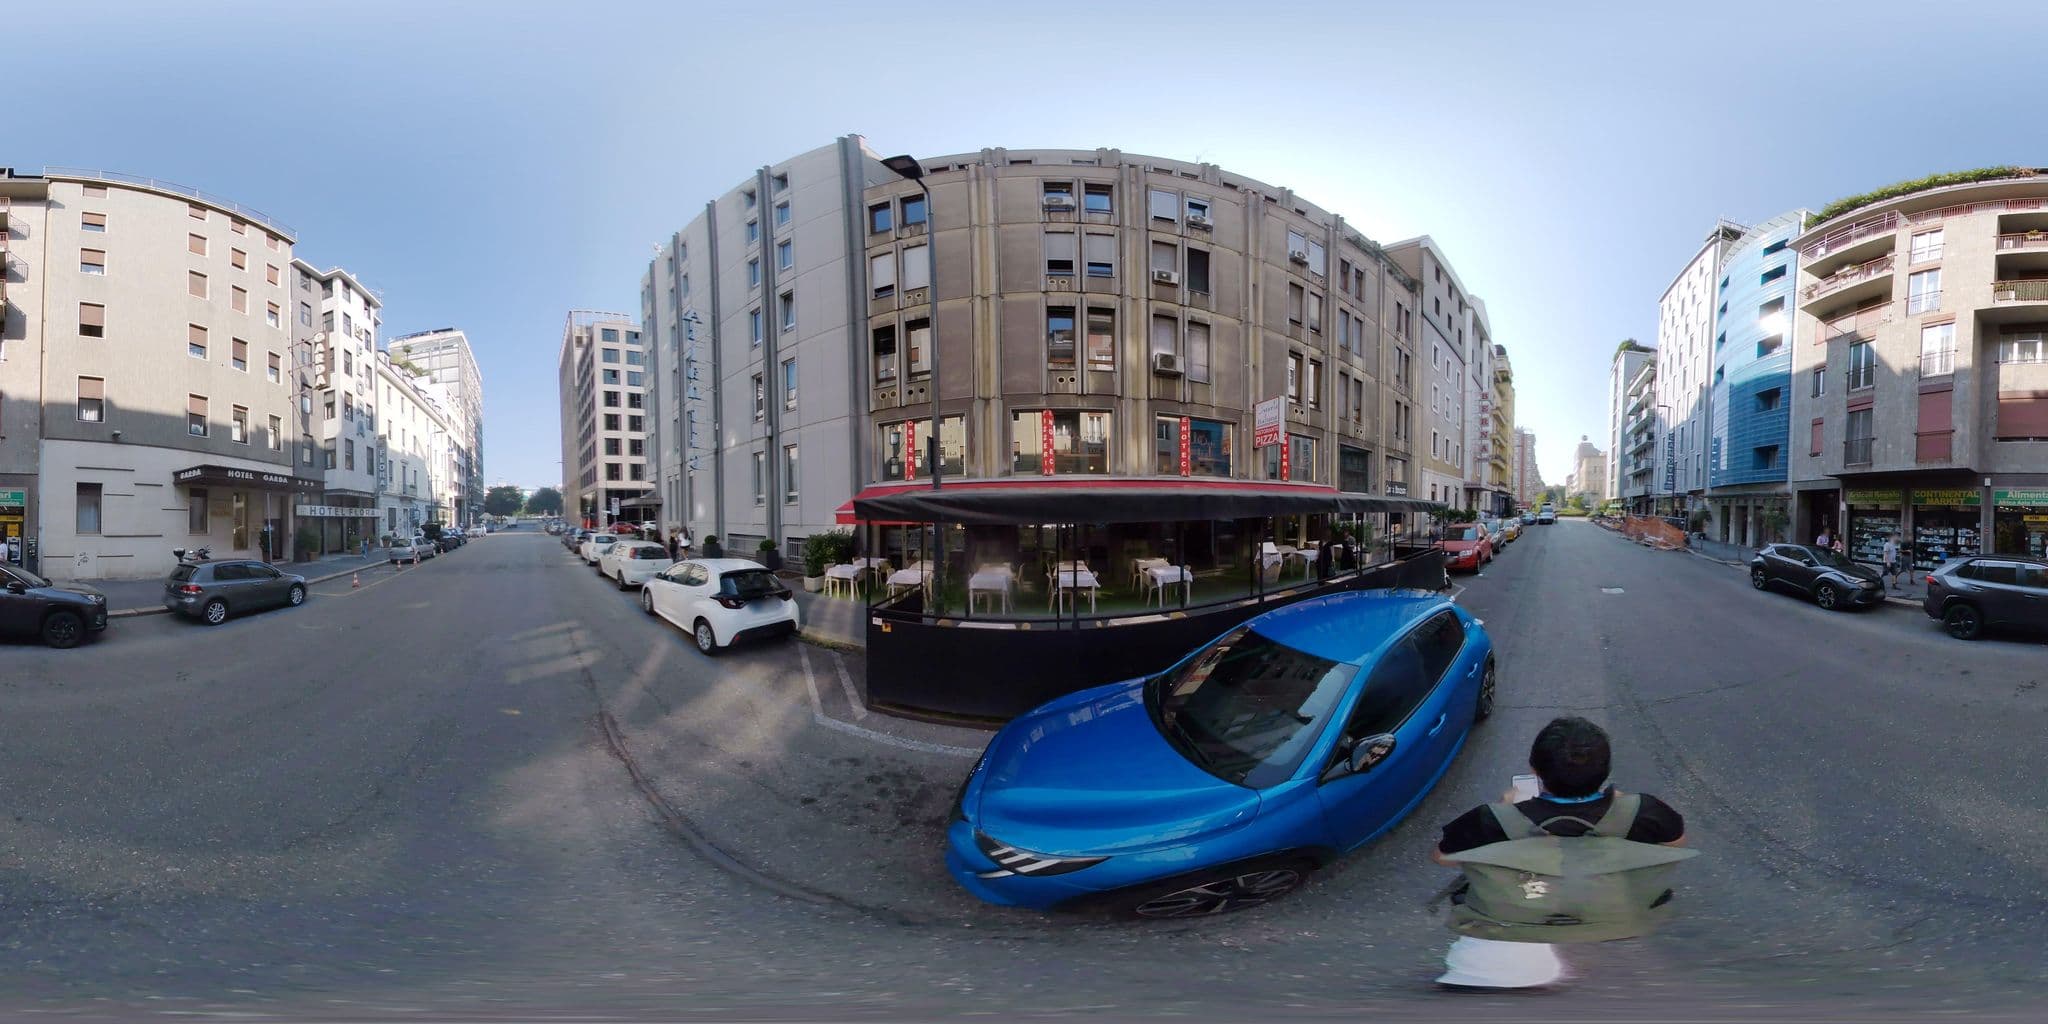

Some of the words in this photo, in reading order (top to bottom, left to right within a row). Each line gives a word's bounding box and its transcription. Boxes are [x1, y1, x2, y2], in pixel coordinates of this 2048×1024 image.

[314, 332, 326, 386] GARDA
[1479, 392, 1489, 452] BERNA
[1256, 432, 1279, 447] PIZZA
[180, 469, 202, 480] GARDA
[227, 470, 254, 480] HOTEL
[263, 474, 288, 483] GARDA
[1914, 490, 1979, 498] CONTINENTAL
[1926, 497, 1965, 505] MARKET
[310, 506, 345, 516] HOTEL
[349, 508, 376, 516] FLORA
